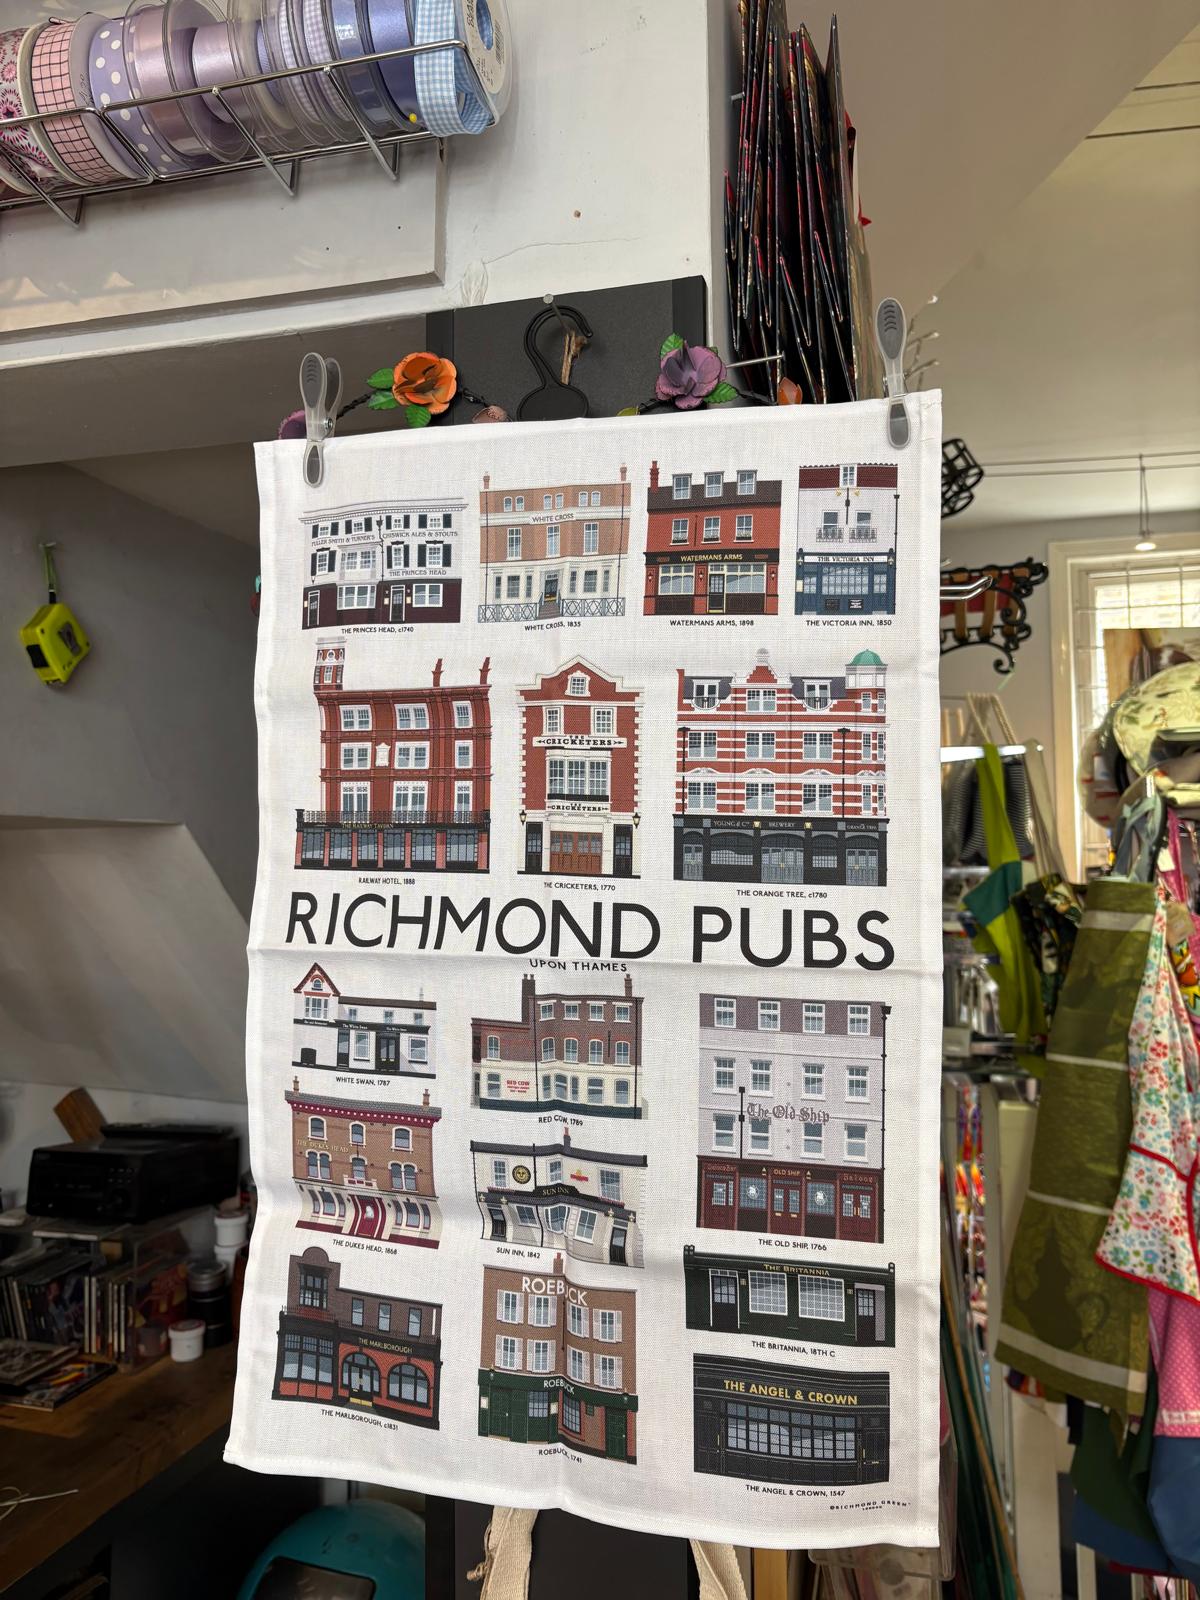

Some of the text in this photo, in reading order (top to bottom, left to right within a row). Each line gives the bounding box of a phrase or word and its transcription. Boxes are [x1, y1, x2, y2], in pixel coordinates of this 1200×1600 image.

[532, 513, 574, 523] WHITE CROSS
[545, 621, 566, 629] CROSS,
[382, 877, 402, 885] HOTEL,
[554, 882, 599, 891] CRICKETERS,
[736, 889, 751, 897] THE
[752, 889, 784, 898] ORANGE
[786, 891, 807, 899] TREE,
[285, 891, 895, 971] RICHMOND PUBS
[530, 959, 627, 972] UPON THAMES
[355, 1078, 376, 1086] SWAN,
[377, 1079, 391, 1087] 1787
[746, 1102, 830, 1125] The Old Ship
[538, 1115, 584, 1126] RED COW, 1789
[773, 1168, 800, 1177] OLD SHIP
[542, 1186, 569, 1196] SUN INN
[333, 1239, 344, 1247] THE
[345, 1241, 365, 1249] DUKES
[366, 1244, 384, 1253] HEAD,
[758, 1238, 827, 1251] THE OLD SHIP, 1766
[511, 1249, 525, 1258] INN,
[527, 1251, 541, 1259] 1842
[764, 1264, 830, 1277] THE BRITANNIA
[359, 1337, 413, 1353] THE MARLBOROUGH
[751, 1340, 836, 1358] THE BRITANNIA, 18TH C
[724, 1379, 858, 1405] THE ANGEL & CROWN
[335, 1411, 383, 1428] MARLBOROUGH,
[745, 1484, 760, 1493] THE
[762, 1486, 787, 1495] ANGEL
